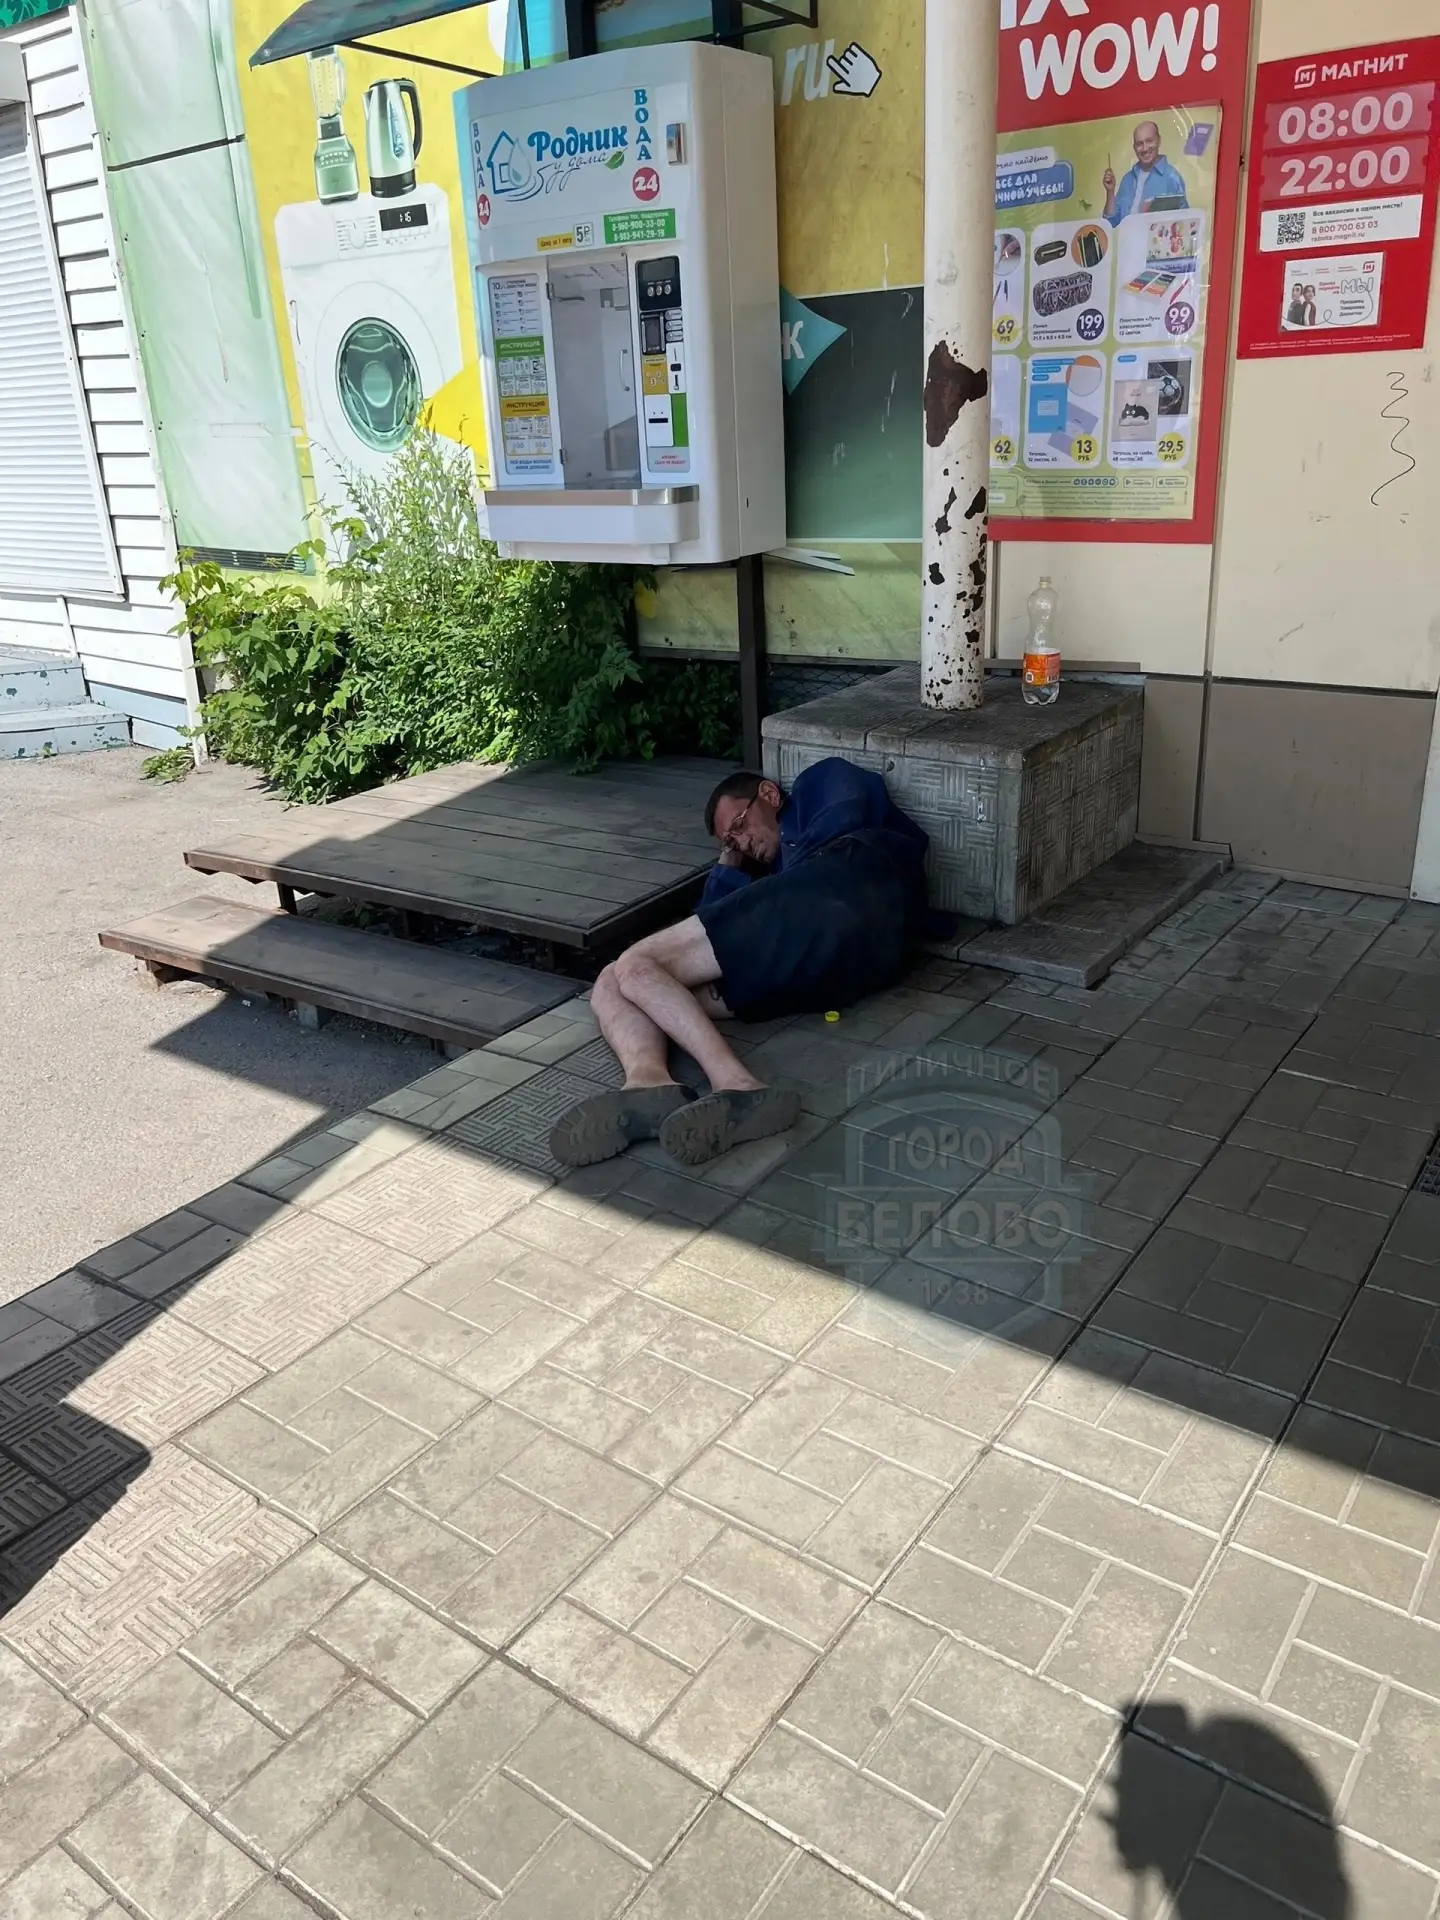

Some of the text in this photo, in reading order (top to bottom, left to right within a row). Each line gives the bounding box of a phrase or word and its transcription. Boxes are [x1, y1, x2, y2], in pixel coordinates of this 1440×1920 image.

[1019, 3, 1219, 100] WOW!
[1321, 54, 1408, 81] МАГНИТ
[634, 89, 652, 161] ВОДА
[1278, 92, 1413, 144] 08:00
[527, 126, 629, 162] Родник
[473, 122, 485, 189] ВОДА
[1280, 146, 1410, 196] 22:00
[635, 174, 658, 192] 24
[1015, 173, 1038, 187] ДЛЯ
[478, 200, 489, 217] 24
[1325, 208, 1354, 216] вакансии
[1319, 225, 1336, 233] 800
[1337, 223, 1353, 231] 700
[1368, 220, 1379, 228] 03
[1311, 231, 1365, 242] rabota.magnit.ru
[1079, 314, 1102, 330] 199
[1169, 307, 1190, 325] 99
[997, 319, 1014, 335] 69
[500, 340, 541, 349] ИНСТРУКЦИЯ
[506, 401, 546, 409] ИНСТРУКЦИЯ
[994, 440, 1012, 454] 62
[1076, 439, 1093, 454] 13
[1158, 440, 1184, 455] 29,5
